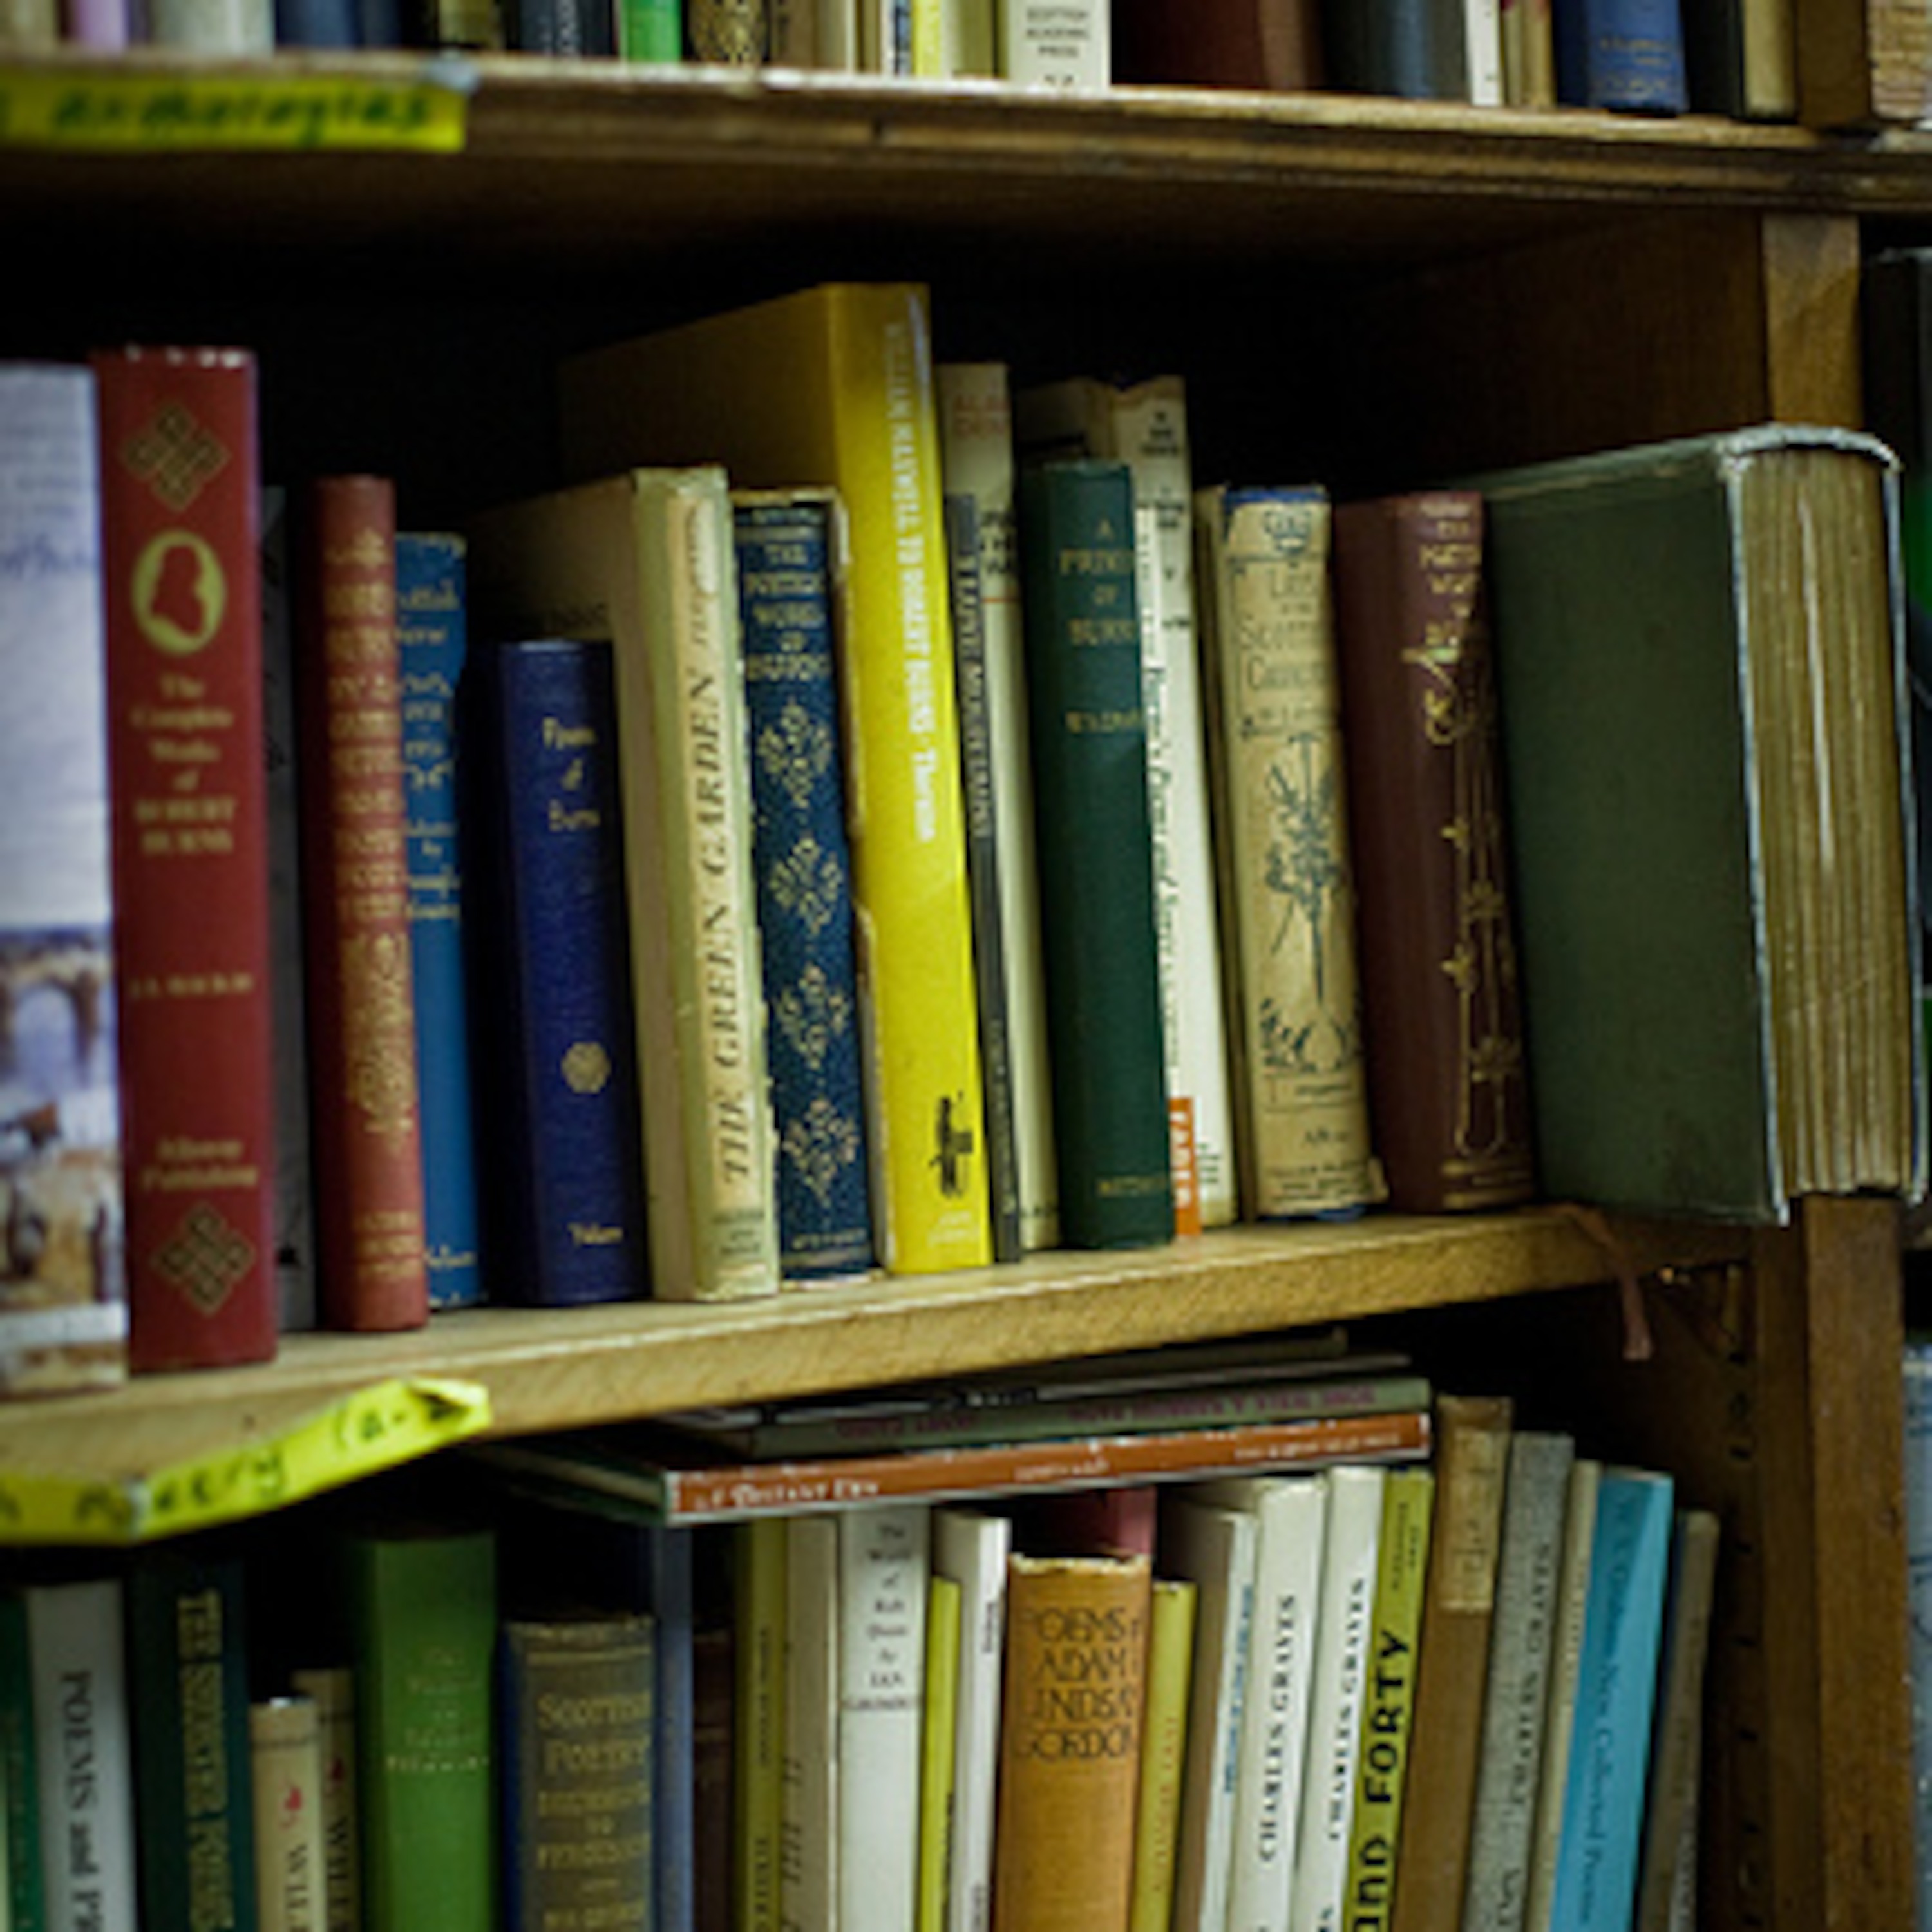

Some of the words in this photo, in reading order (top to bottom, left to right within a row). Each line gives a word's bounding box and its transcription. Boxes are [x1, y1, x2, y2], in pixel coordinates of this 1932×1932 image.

[896, 536, 925, 565] TO
[900, 567, 931, 656] ROBERT
[904, 659, 936, 733] BURNS
[688, 667, 727, 876] GARDEN
[701, 903, 740, 1069] GREEN
[1271, 1593, 1294, 1712] GRAVES
[1327, 1704, 1353, 1841] CHARLES
[1341, 1578, 1365, 1696] GRAVES
[1363, 1628, 1411, 1807] FORTY
[60, 1669, 98, 1812] POEMS
[1258, 1723, 1285, 1864] CHARLES
